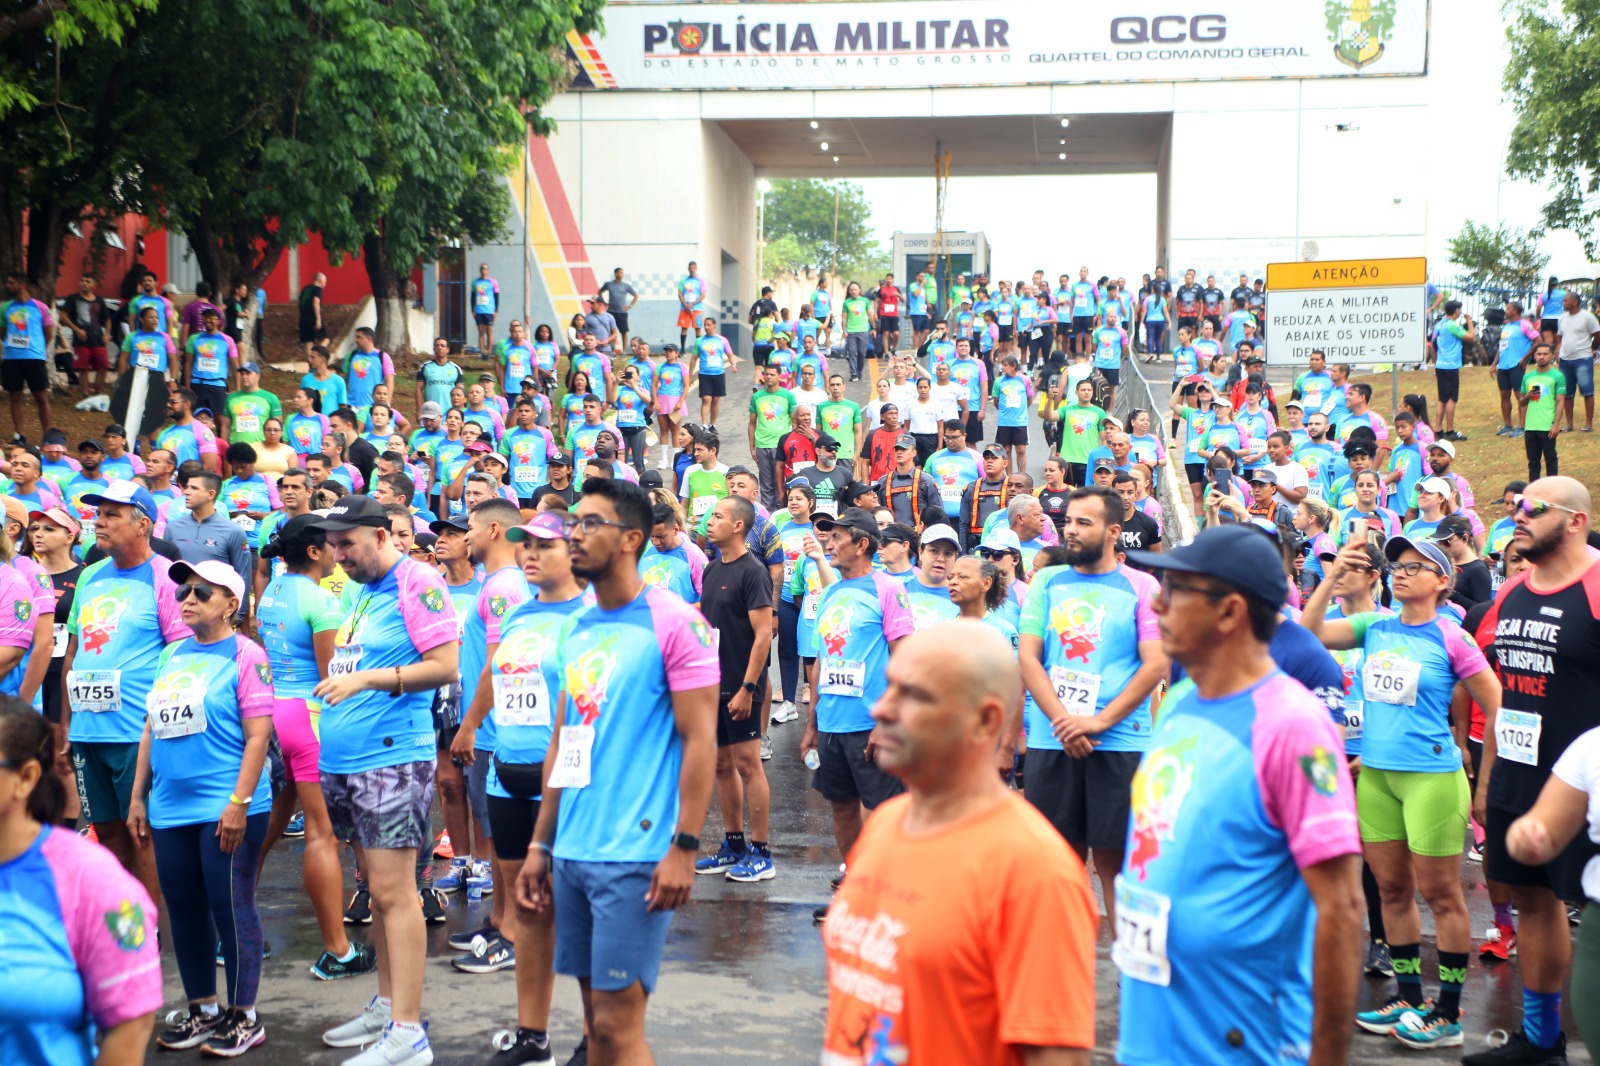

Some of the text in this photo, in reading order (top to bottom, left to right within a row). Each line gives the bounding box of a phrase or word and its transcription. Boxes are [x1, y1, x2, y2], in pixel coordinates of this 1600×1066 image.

[835, 18, 1010, 51] MILITAR
[1110, 14, 1228, 44] QCG
[643, 54, 1011, 68] DO ESTADO DE MATO GROSSO
[1029, 46, 1310, 64] QUARTEL DO COMANDO GERAL
[903, 239, 929, 248] CORPO
[1312, 265, 1379, 282] ATENÇÃO
[1302, 296, 1389, 309] ÁREA MILITAR
[1273, 312, 1417, 326] REDUZA A VELOCIDADE
[1285, 328, 1405, 342] ABAIXE OS VIDROS
[1381, 345, 1396, 356] SE
[518, 471, 536, 479] 2024
[236, 518, 252, 526] 878
[1495, 618, 1561, 643] SEJA FORTE
[1508, 649, 1555, 674] INSPIRA
[1373, 673, 1404, 692] 706
[1517, 674, 1548, 698] VOCÊ
[73, 685, 114, 700] 1755
[505, 692, 537, 709] 210
[1057, 684, 1089, 704] 872
[160, 704, 194, 723] 674
[1501, 728, 1533, 748] 1702
[77, 769, 92, 818] adidas
[754, 860, 767, 872] FILA
[488, 948, 509, 965] FILA
